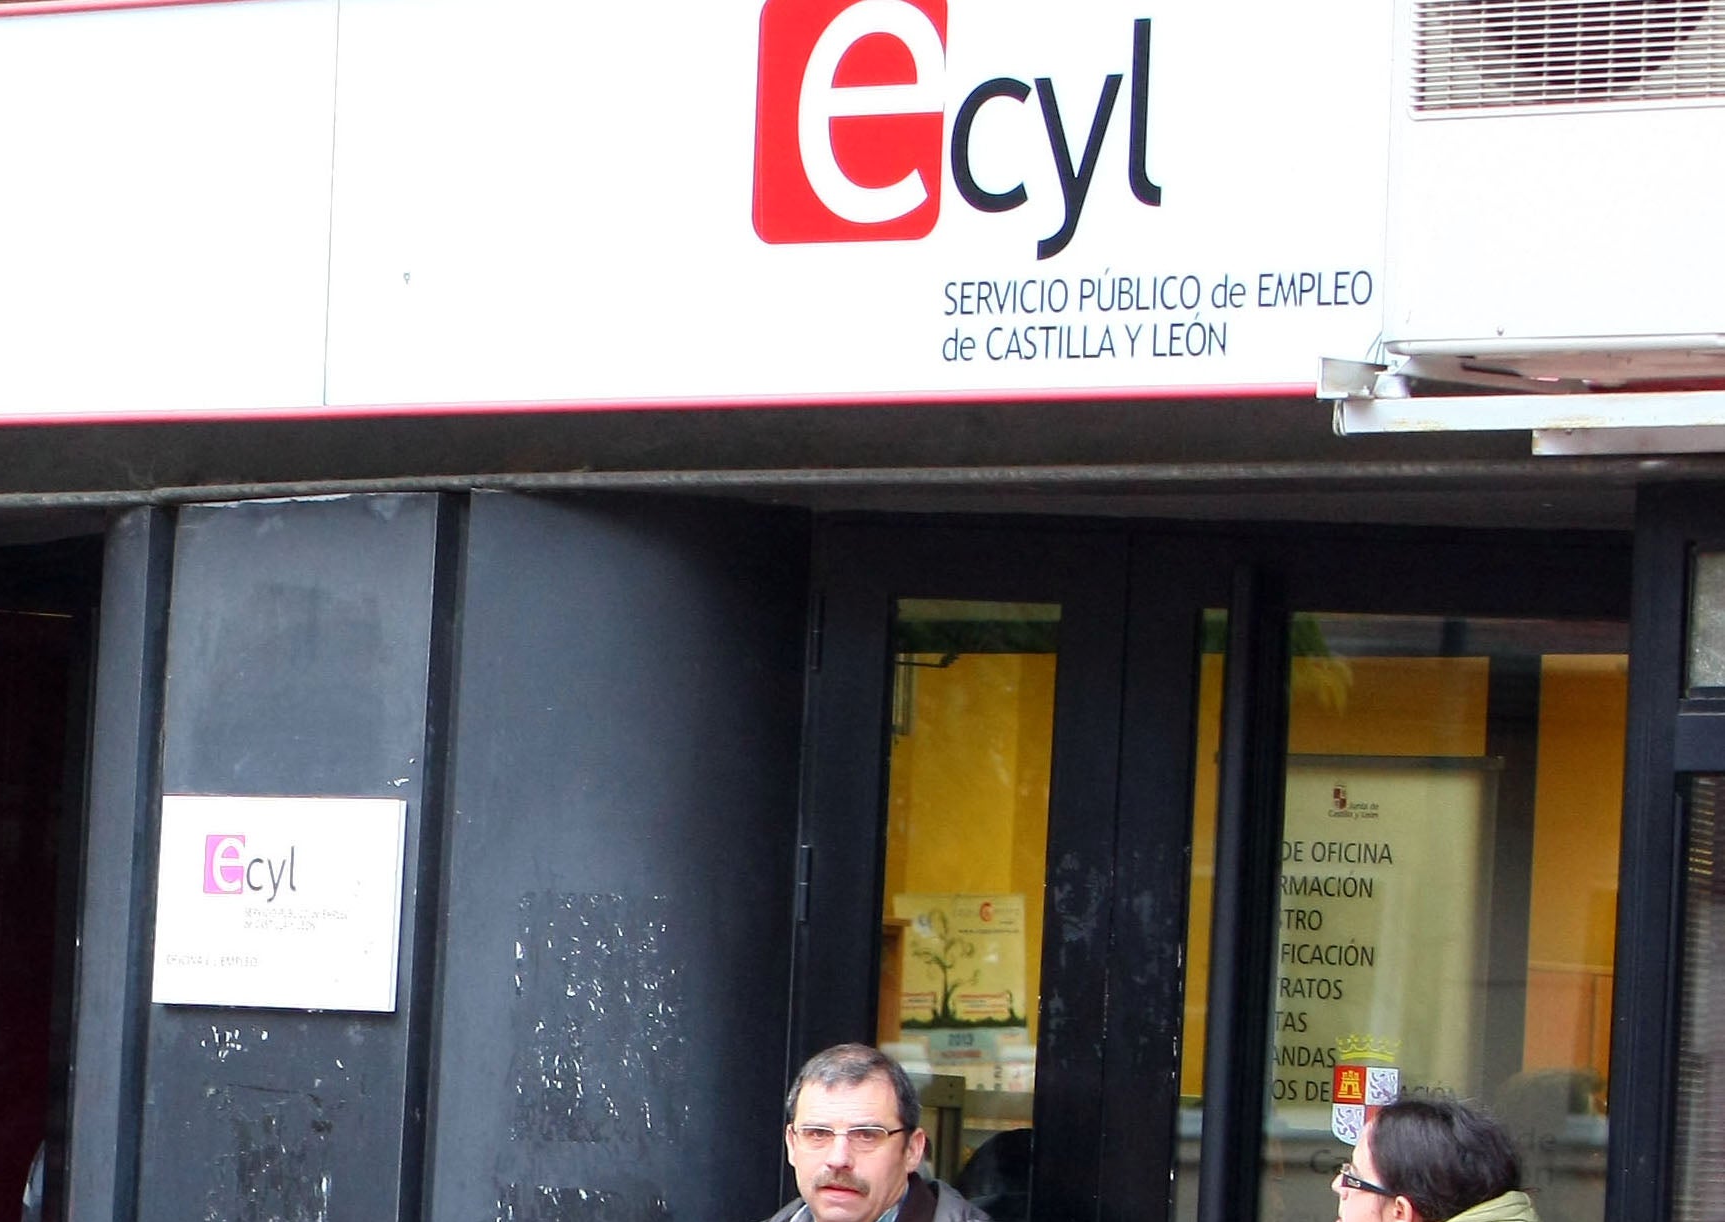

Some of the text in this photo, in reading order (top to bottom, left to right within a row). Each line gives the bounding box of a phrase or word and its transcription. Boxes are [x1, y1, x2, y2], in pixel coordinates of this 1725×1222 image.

[798, 0, 1161, 259] ecyl
[944, 267, 1373, 315] SERVICIO PÚBLICO de EMPLEO
[942, 312, 1227, 362] de CASTILLA Y LEÓN
[1311, 841, 1394, 865] OFICINA
[212, 837, 296, 903] ecyl
[1279, 869, 1374, 898] RMACIÓN
[1278, 909, 1323, 931] TRO
[1281, 937, 1375, 967] FICACIÓN
[1278, 976, 1343, 1000] RATOS
[1275, 1011, 1307, 1032] TAS
[1273, 1046, 1336, 1068] ANDAS
[1272, 1079, 1330, 1102] OS DE
